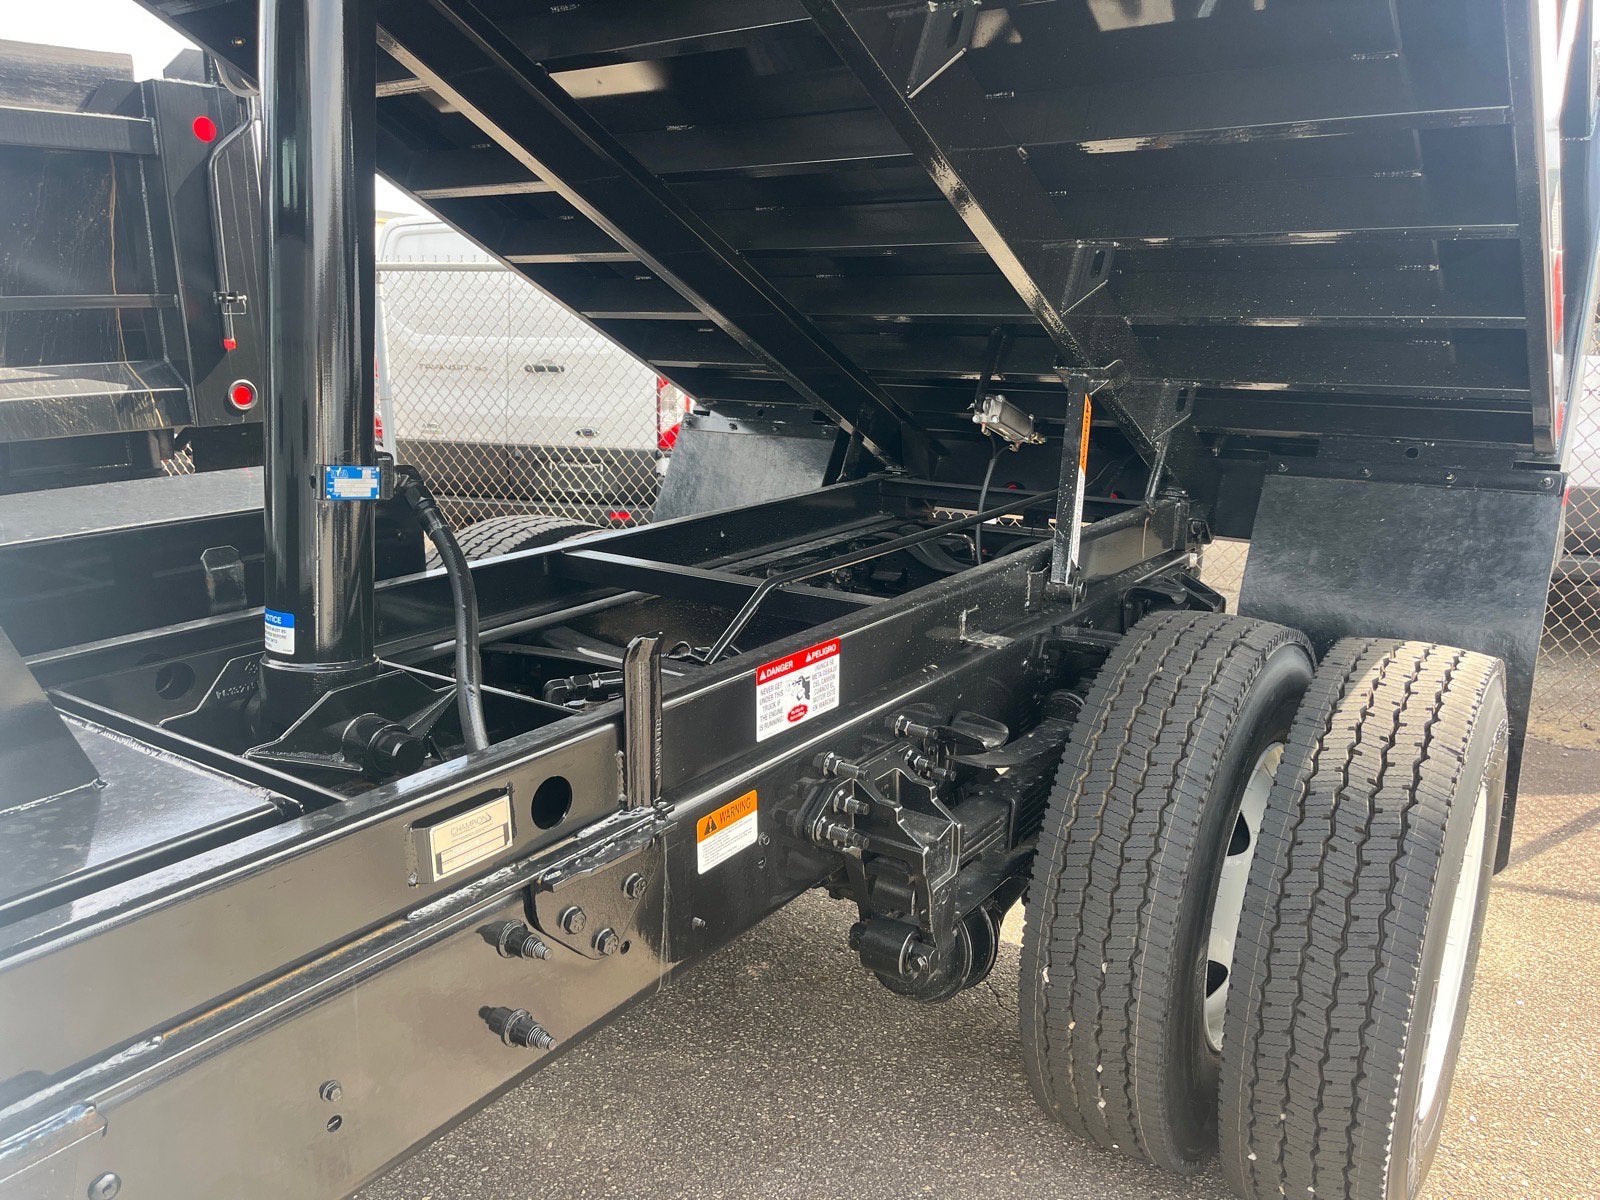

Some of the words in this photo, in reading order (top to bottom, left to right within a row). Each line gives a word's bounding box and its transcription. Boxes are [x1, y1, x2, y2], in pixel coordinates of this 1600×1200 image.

[811, 643, 837, 660] PELIGRO
[829, 658, 835, 666] SE
[766, 660, 794, 678] DANGER
[812, 670, 822, 680] META
[760, 685, 774, 695] NEVER
[775, 682, 783, 691] GET
[813, 679, 821, 688] DEL
[813, 683, 830, 696] CUANDO
[760, 694, 774, 706] UNDER
[774, 689, 784, 699] THIS
[813, 692, 826, 703] MOTOR
[763, 702, 777, 713] TRUCK
[777, 698, 782, 707] IF
[812, 704, 818, 712] EN
[760, 713, 768, 723] THE
[769, 707, 783, 719] ENGINE
[759, 724, 765, 732] IS
[720, 797, 752, 825] WARNING
[450, 814, 490, 836] CHAMPION
